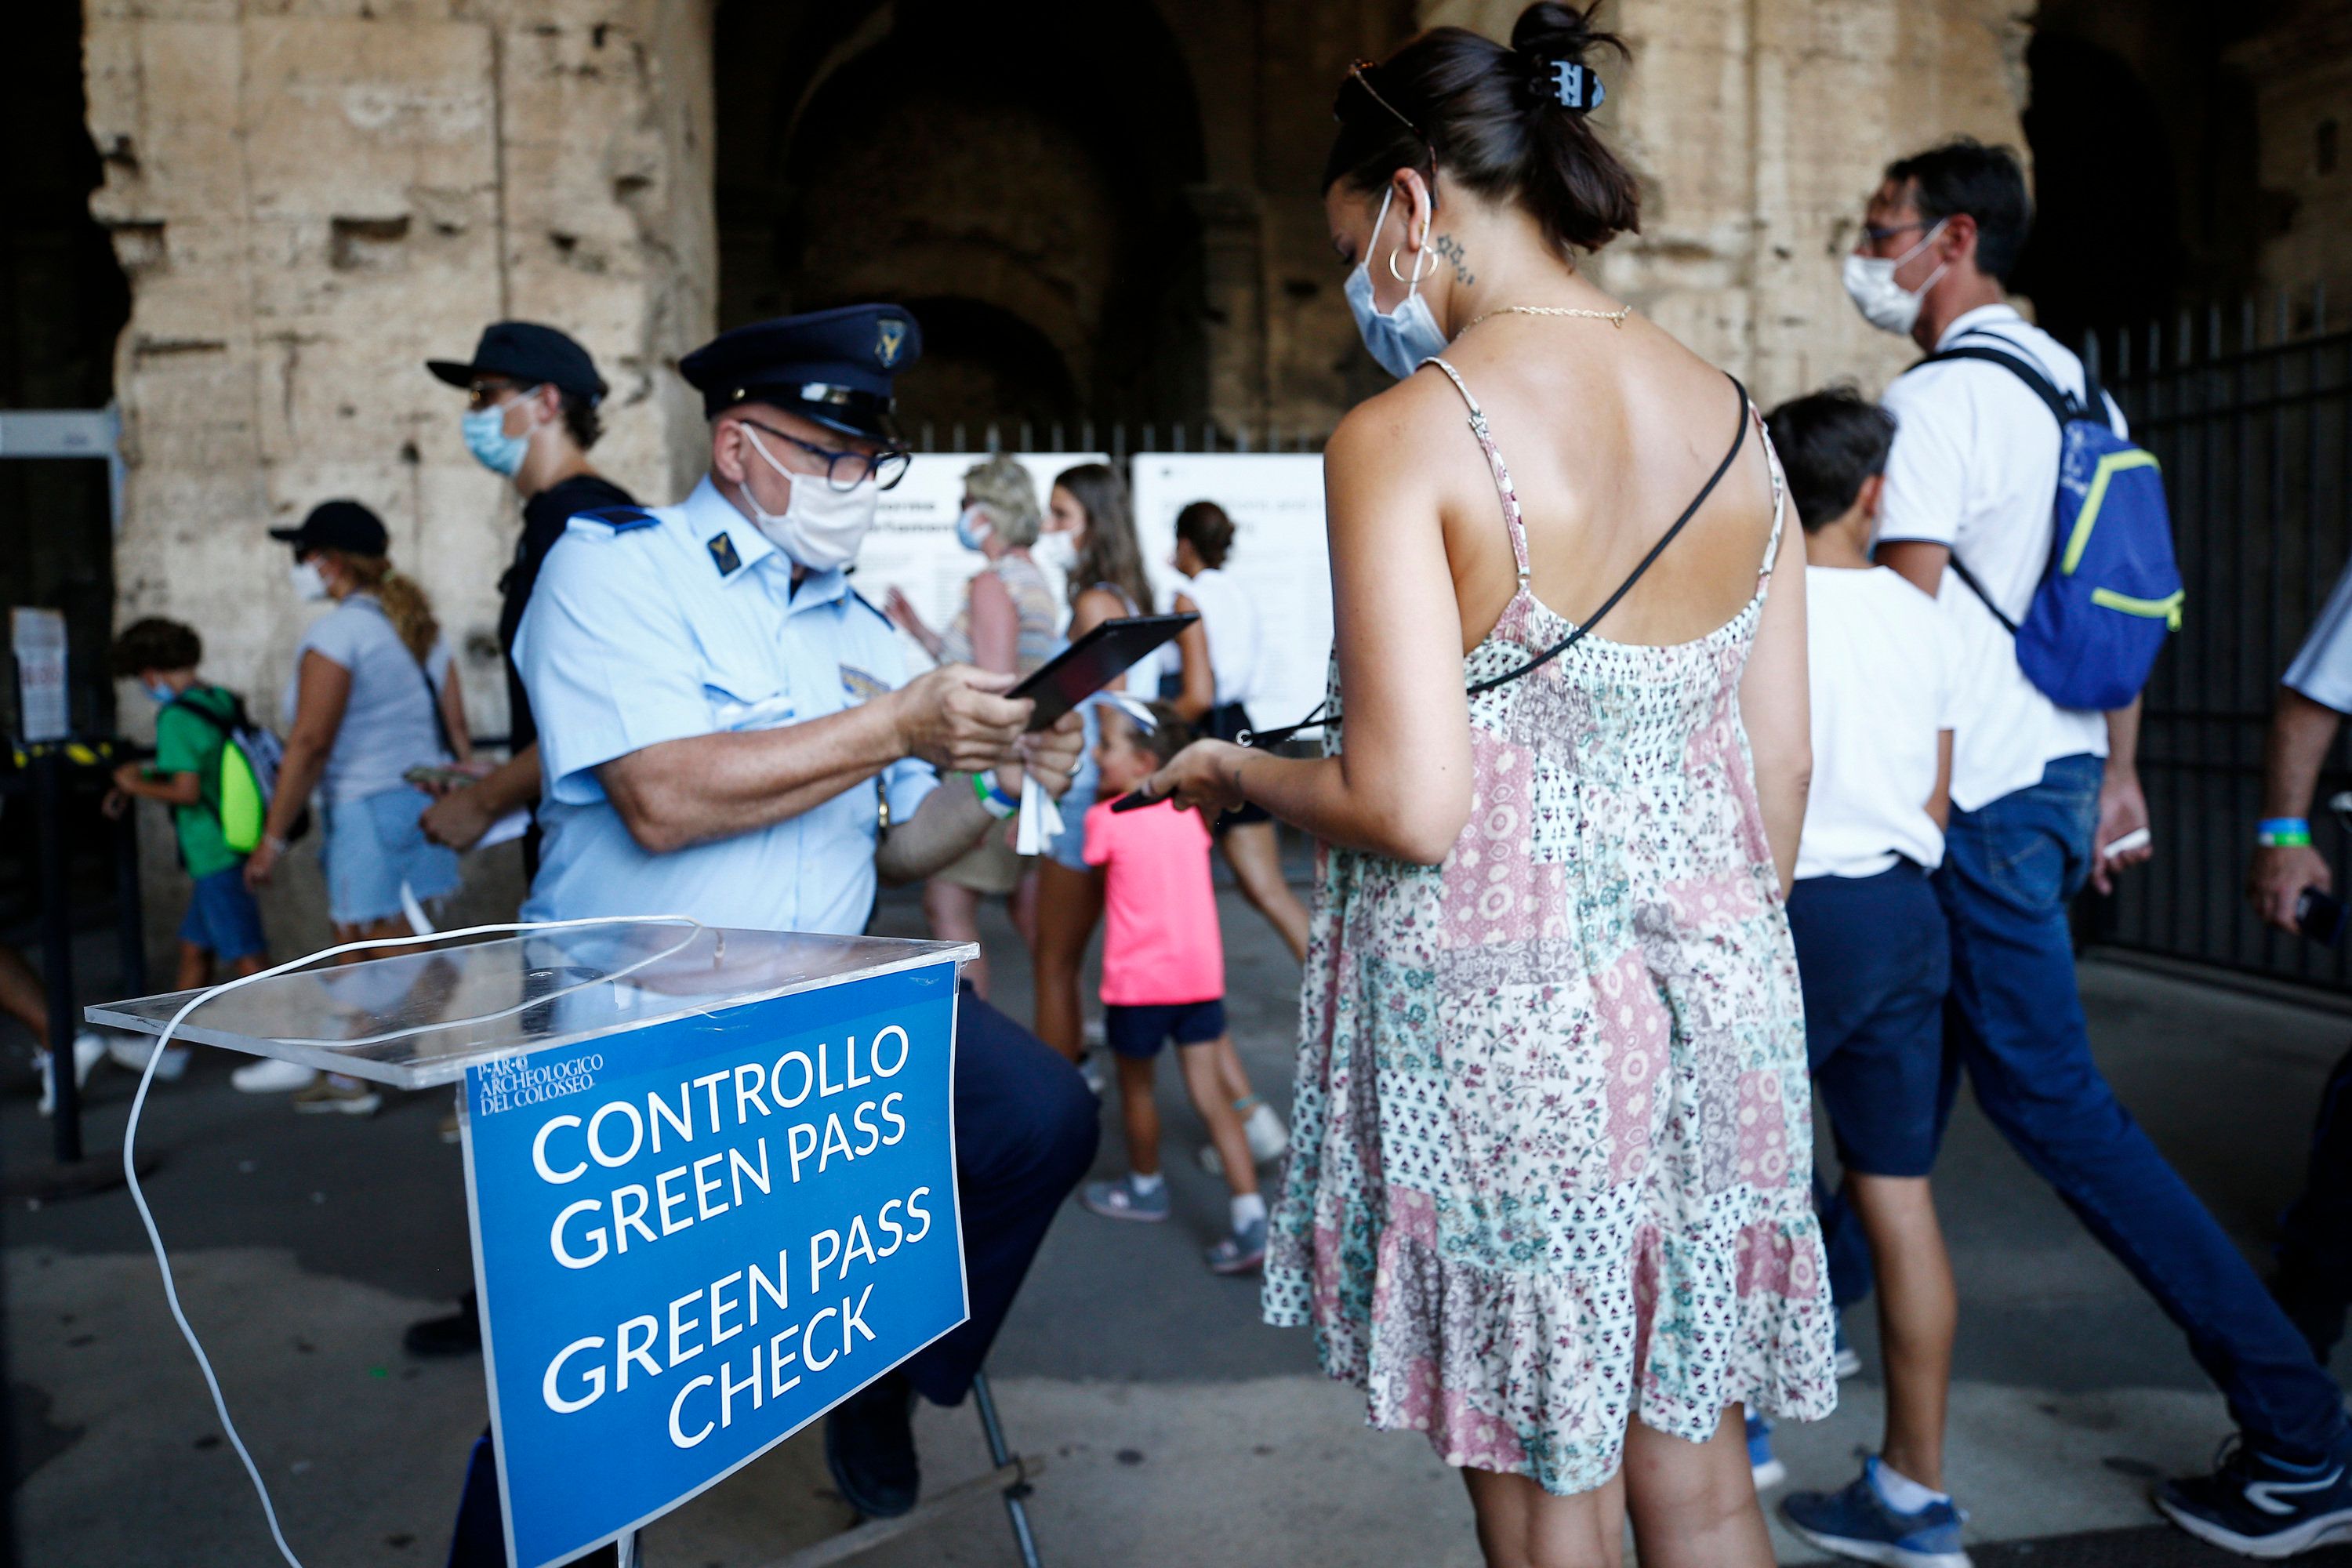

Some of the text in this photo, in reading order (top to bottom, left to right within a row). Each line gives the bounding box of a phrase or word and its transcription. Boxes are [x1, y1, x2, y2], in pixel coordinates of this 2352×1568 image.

[479, 1053, 604, 1098] ARCHEOLOGICO
[480, 1073, 595, 1117] DEL COLOSSEO
[532, 1025, 909, 1185] CONTROLLO
[550, 1091, 906, 1269] GREEN PASS
[543, 1186, 931, 1414] GREEN PASS
[669, 1283, 877, 1449] CHECK
